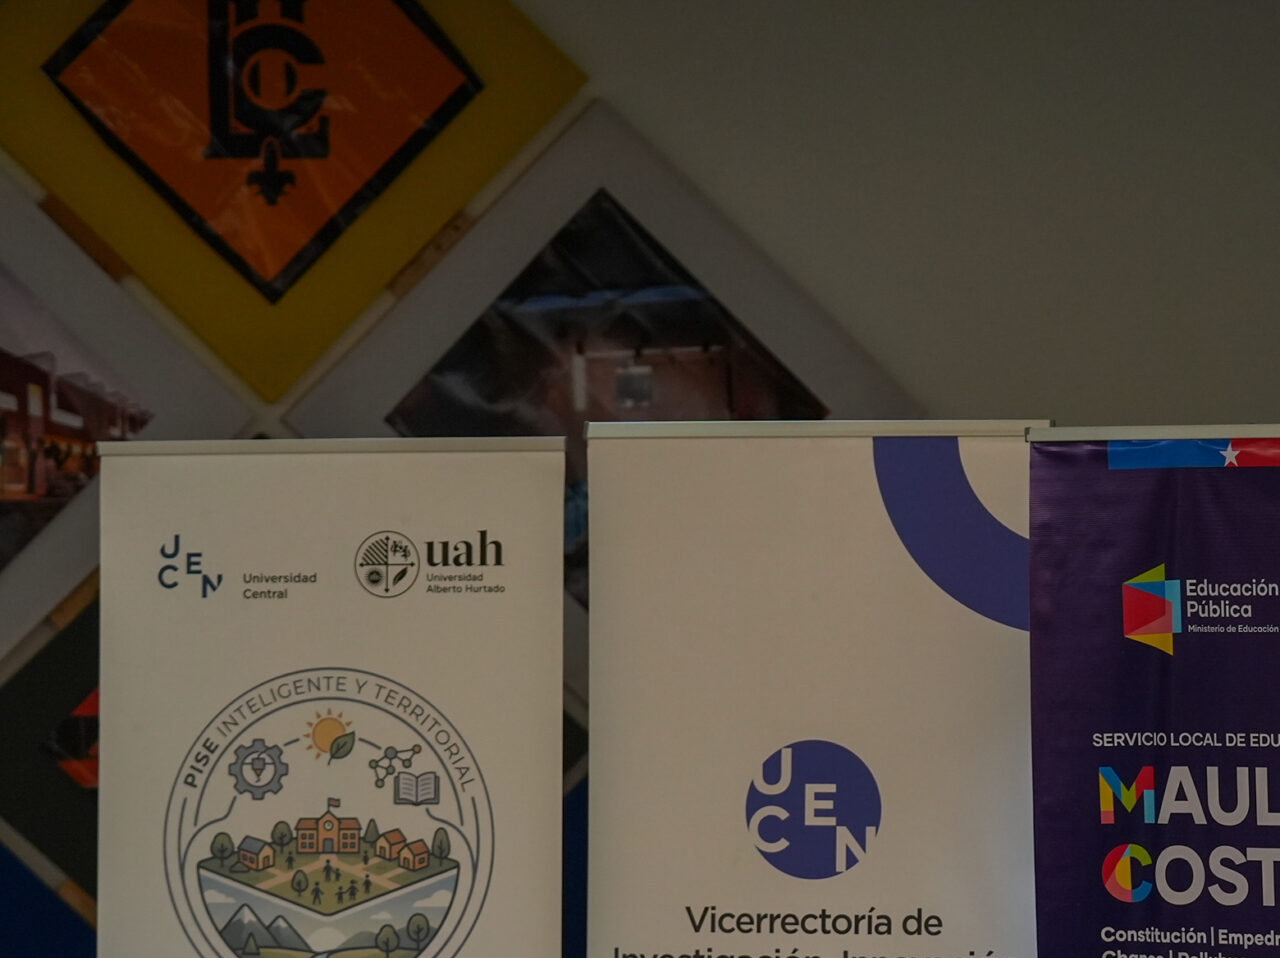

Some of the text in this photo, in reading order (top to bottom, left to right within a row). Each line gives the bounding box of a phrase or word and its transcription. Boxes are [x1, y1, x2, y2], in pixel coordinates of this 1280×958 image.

[426, 530, 503, 567] uah
[243, 573, 317, 584] Universidad
[426, 573, 483, 582] Universidad
[243, 589, 287, 599] Central
[426, 585, 505, 593] Alberto Hurtado
[1186, 579, 1278, 596] Educación
[1187, 600, 1251, 617] Pública
[1188, 624, 1224, 633] Ministerio
[1226, 624, 1236, 633] de
[182, 675, 477, 793] PISE INTELIGENTE Y TERRITORIAL
[1093, 732, 1166, 746] SERVICIO
[1171, 733, 1222, 746] LOCAL
[1226, 733, 1246, 746] DE
[685, 906, 942, 936] Vicerrectoría de
[1101, 927, 1206, 943] Constitución
